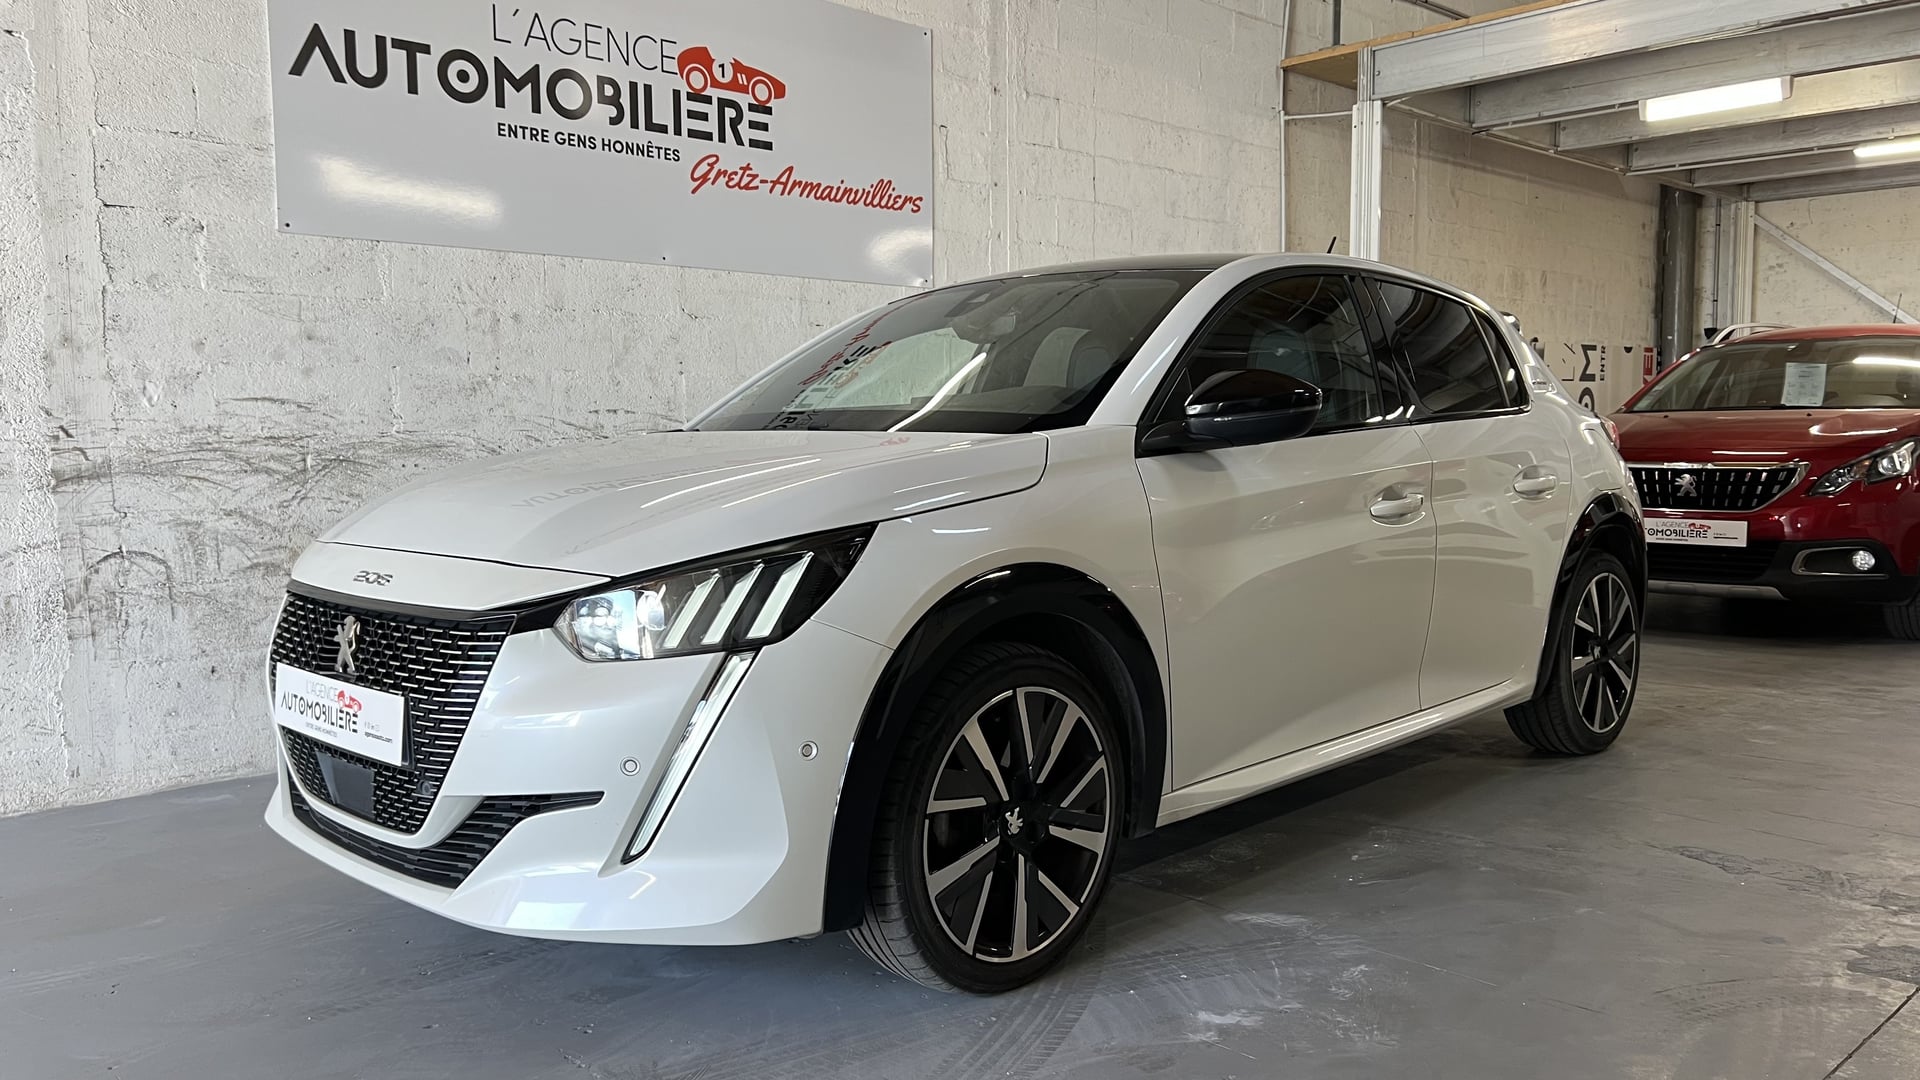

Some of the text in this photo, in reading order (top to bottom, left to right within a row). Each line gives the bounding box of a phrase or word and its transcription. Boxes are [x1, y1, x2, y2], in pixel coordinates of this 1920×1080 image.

[493, 3, 679, 76] L'AGENCE
[497, 121, 681, 162] ENTRE GENS HONNÊTES
[690, 154, 924, 214] Gretz-Armainvilliers
